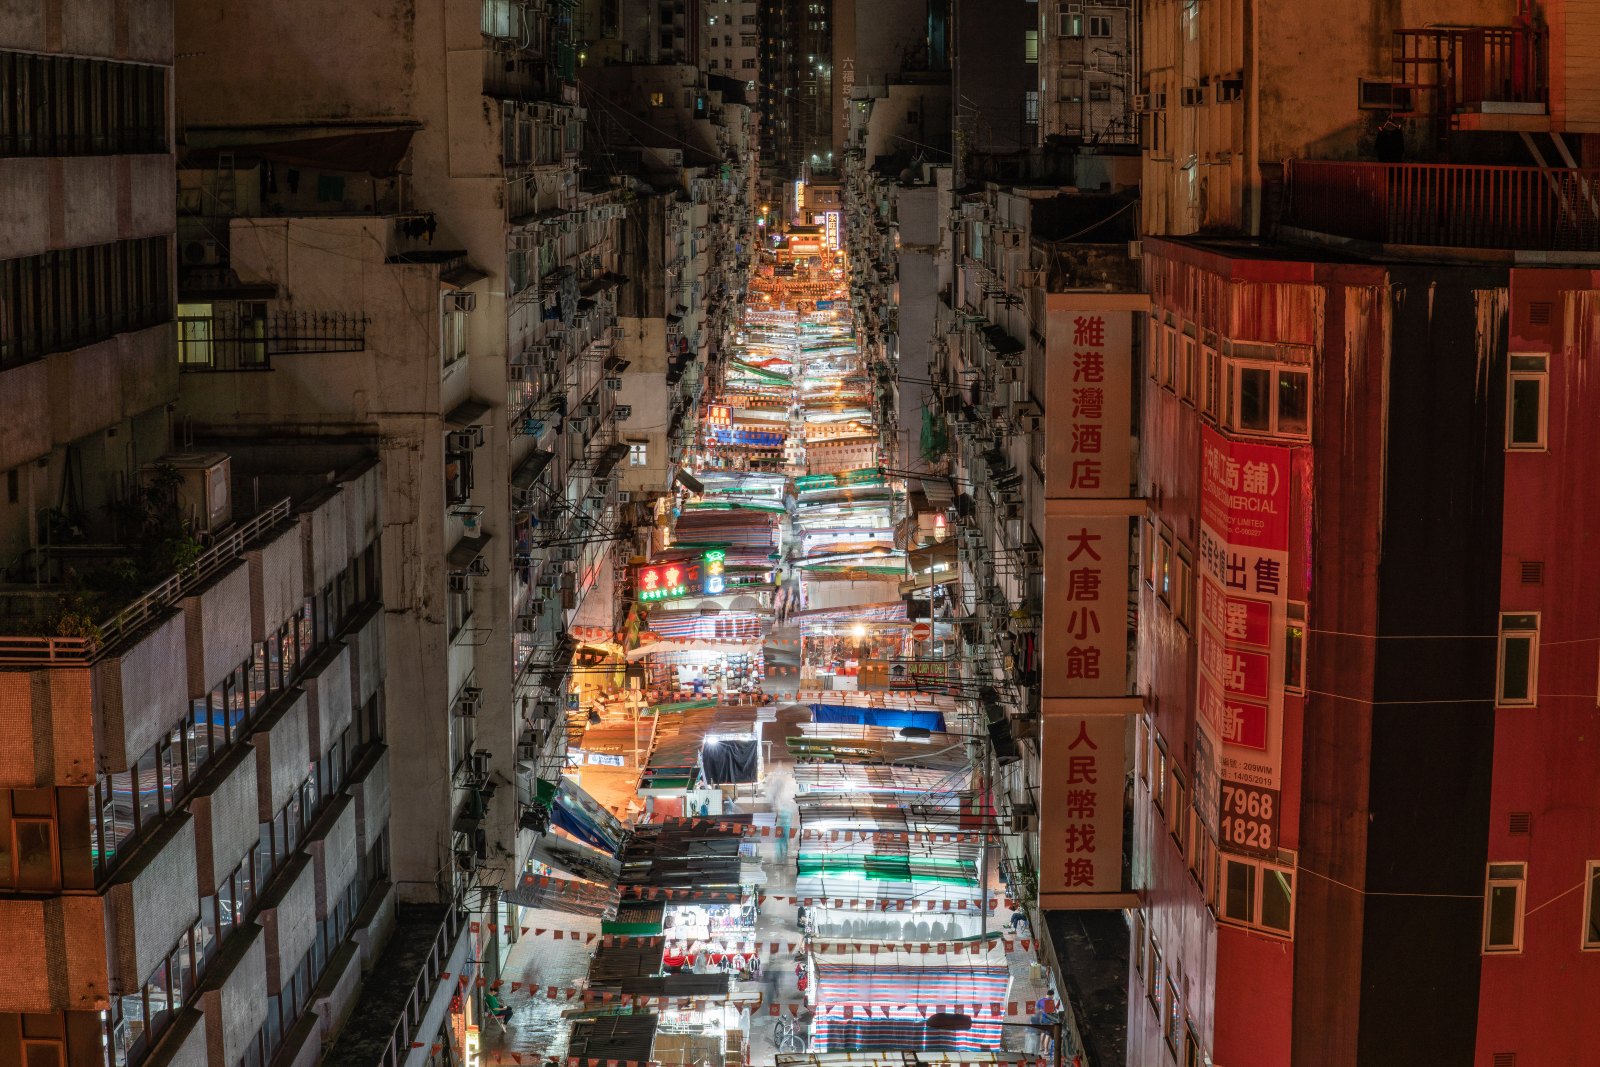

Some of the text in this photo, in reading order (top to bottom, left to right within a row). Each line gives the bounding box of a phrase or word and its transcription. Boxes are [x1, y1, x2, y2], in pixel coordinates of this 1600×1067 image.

[1069, 315, 1105, 490] 維港灣酒店
[1238, 517, 1265, 528] LIMITED
[1066, 528, 1101, 679] 大唐小館
[1233, 771, 1272, 787] 14/05/2019
[1243, 761, 1273, 776] 209WIM
[1064, 720, 1098, 888] 人民幣找換
[1222, 786, 1273, 820] 7968
[1221, 816, 1271, 850] 1828
